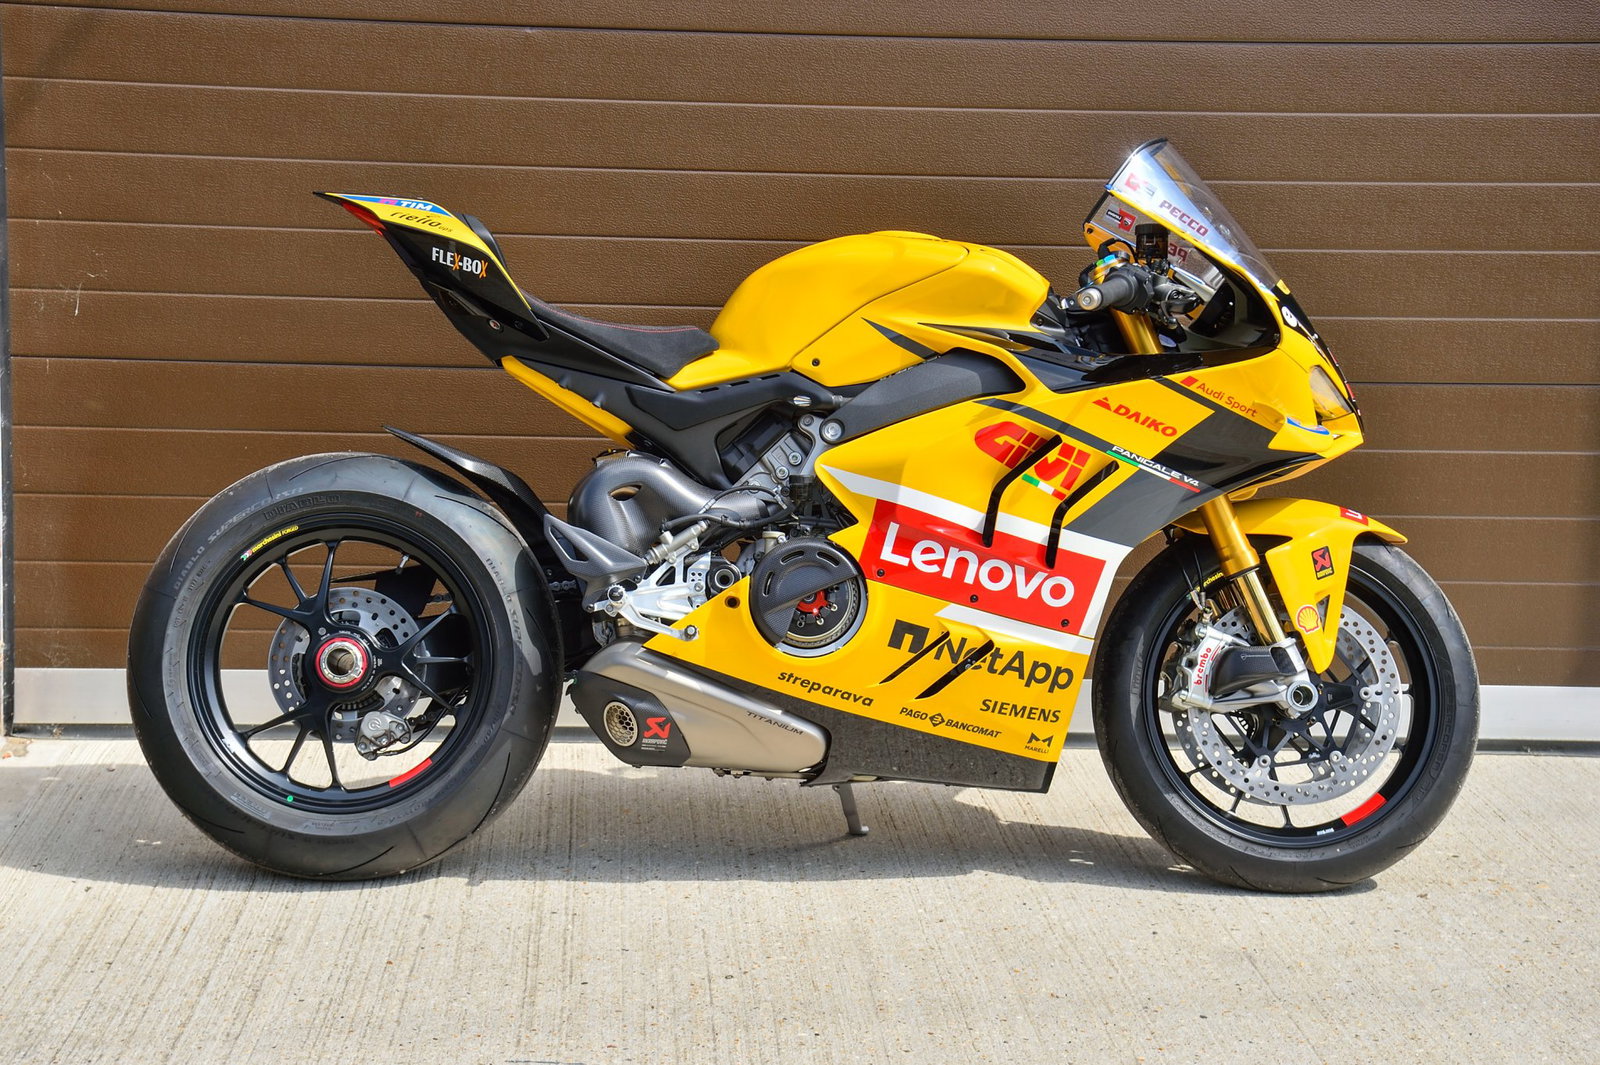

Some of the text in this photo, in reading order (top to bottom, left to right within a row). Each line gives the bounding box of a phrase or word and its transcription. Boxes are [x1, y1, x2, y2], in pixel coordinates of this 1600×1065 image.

[400, 201, 433, 211] TIM
[1158, 200, 1209, 237] PECCO
[432, 246, 488, 279] FLEX-BOX
[1196, 383, 1258, 417] Audi Sport
[1113, 404, 1178, 437] DAIKO
[1112, 445, 1200, 487] PANIGALE V4
[879, 521, 1075, 608] Lenovo
[1194, 648, 1212, 685] brembo
[777, 671, 874, 707] streparava
[746, 711, 804, 736] TITANIUM
[900, 707, 1002, 738] PAGO BANCOMAT
[980, 699, 1061, 723] SIEMENS
[1024, 745, 1050, 754] MARELLI
